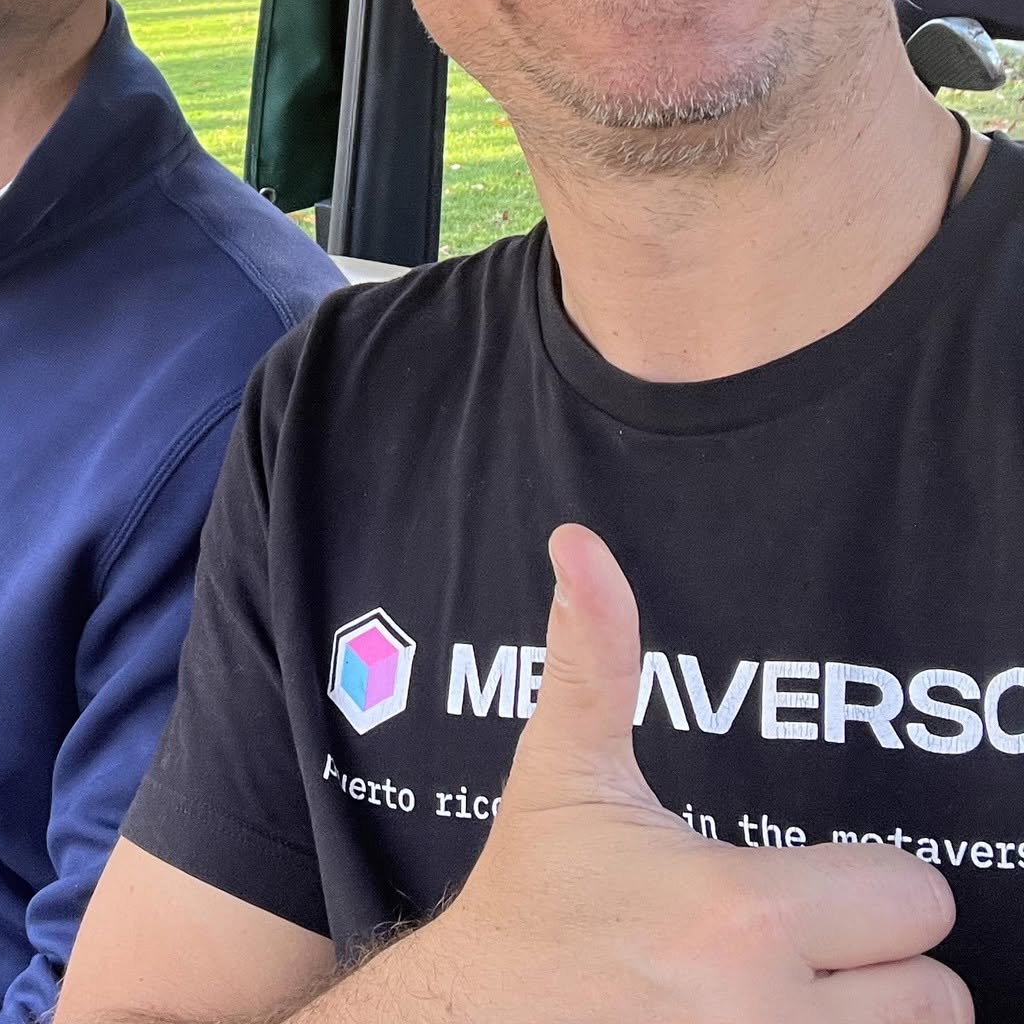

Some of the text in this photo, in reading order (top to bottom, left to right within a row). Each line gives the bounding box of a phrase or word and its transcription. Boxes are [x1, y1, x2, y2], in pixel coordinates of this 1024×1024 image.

[447, 643, 1024, 754] MEAVERS
[682, 803, 718, 840] in
[738, 814, 807, 848] the
